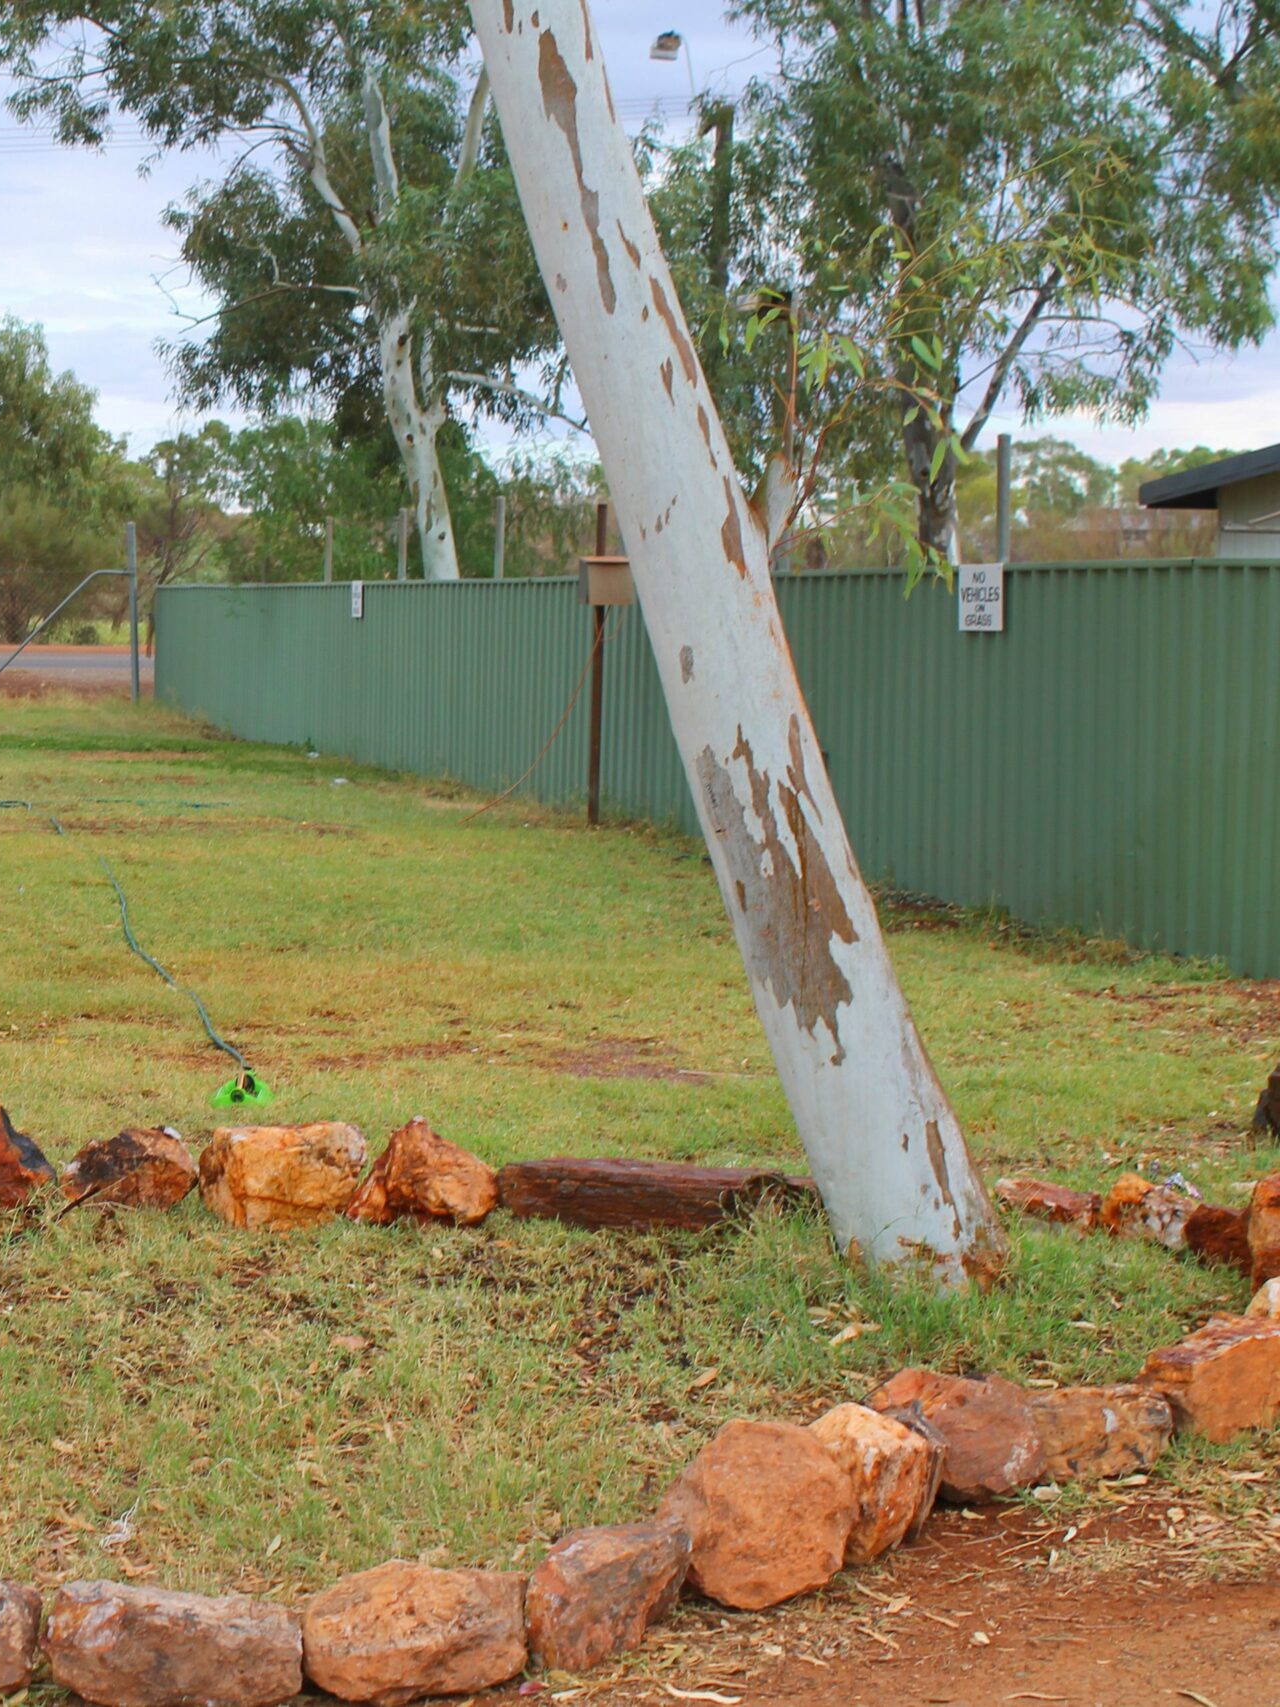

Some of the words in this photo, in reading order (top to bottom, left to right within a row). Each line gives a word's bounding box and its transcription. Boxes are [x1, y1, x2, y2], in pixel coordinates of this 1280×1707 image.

[972, 571, 986, 584] NO
[960, 586, 1000, 603] VEHICLES
[974, 604, 985, 612] ON
[964, 614, 992, 626] GRASS
